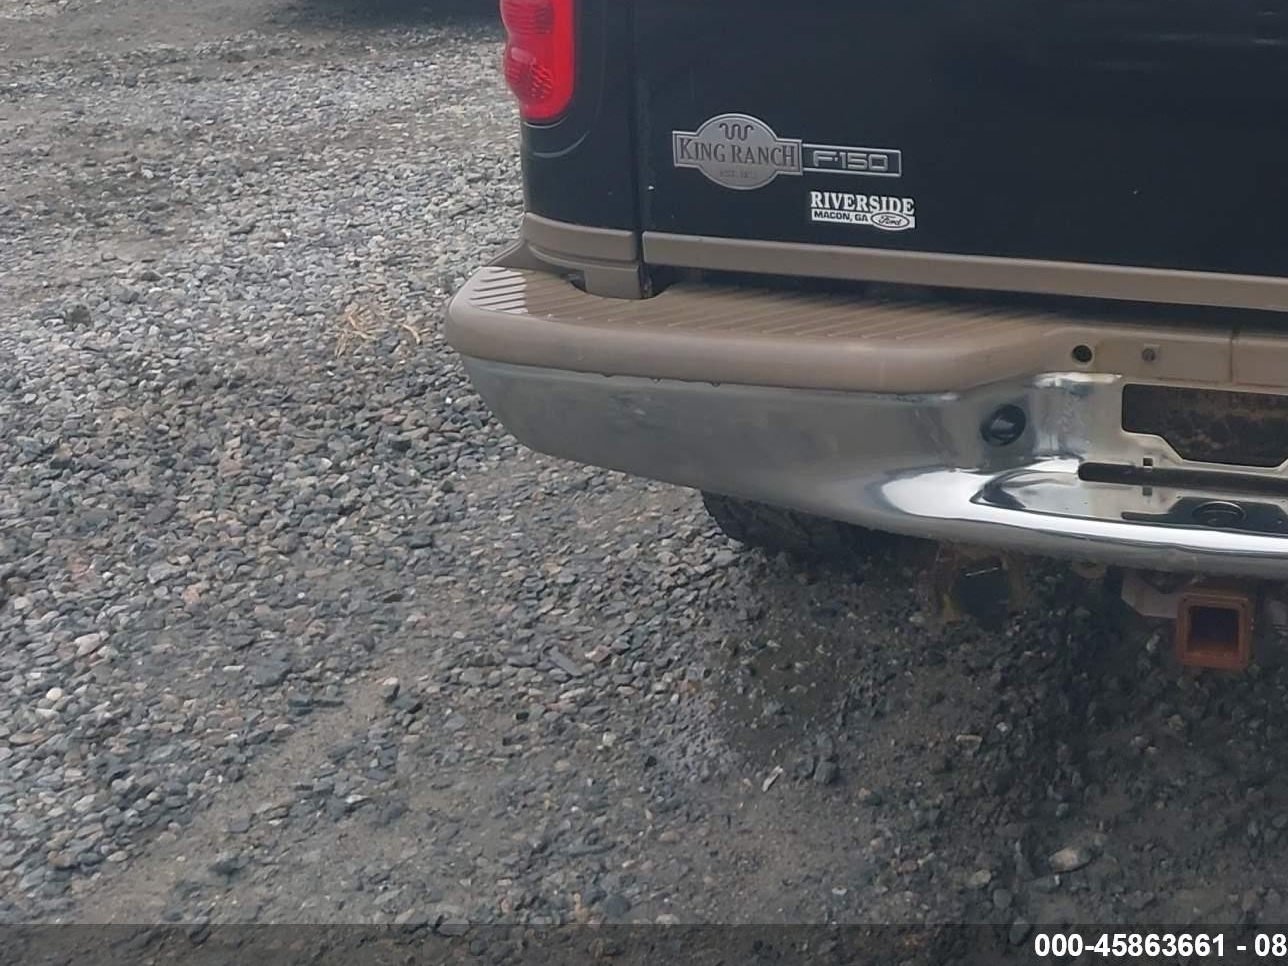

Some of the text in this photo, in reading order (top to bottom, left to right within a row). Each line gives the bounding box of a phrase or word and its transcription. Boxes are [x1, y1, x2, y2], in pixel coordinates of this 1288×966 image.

[679, 137, 796, 168] KING RANCH
[810, 191, 915, 215] RIVERSIDE
[814, 210, 869, 222] MACON, GA
[878, 214, 903, 226] Ford
